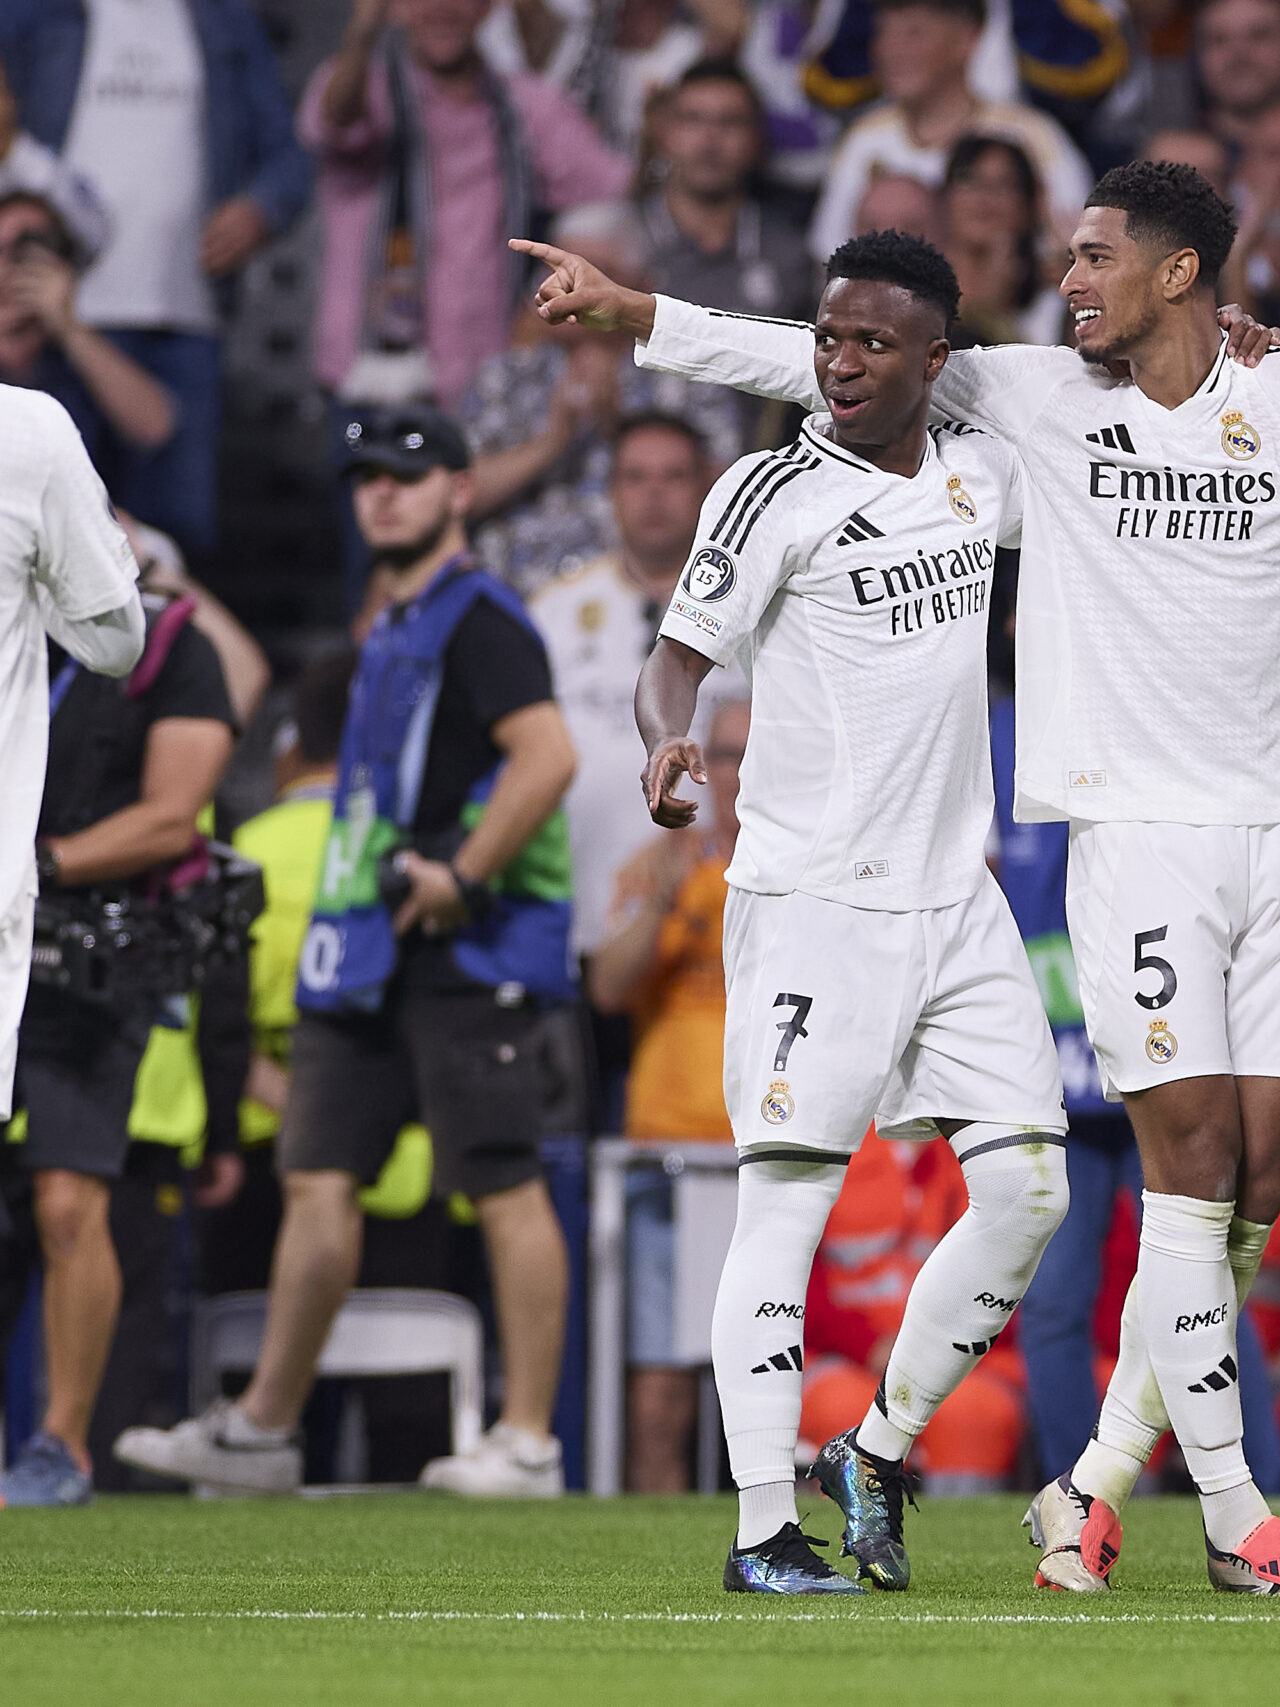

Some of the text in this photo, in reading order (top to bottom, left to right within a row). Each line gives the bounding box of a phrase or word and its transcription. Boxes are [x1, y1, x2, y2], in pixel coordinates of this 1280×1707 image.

[1089, 462, 1276, 505] Emirates
[1117, 508, 1253, 541] FLY BETTER
[696, 570, 715, 585] 15
[848, 539, 993, 606] Emirates
[891, 580, 987, 636] FLY BETTER
[1134, 924, 1177, 1010] 5
[772, 993, 813, 1072] 7
[1174, 1302, 1228, 1333] RMCF
